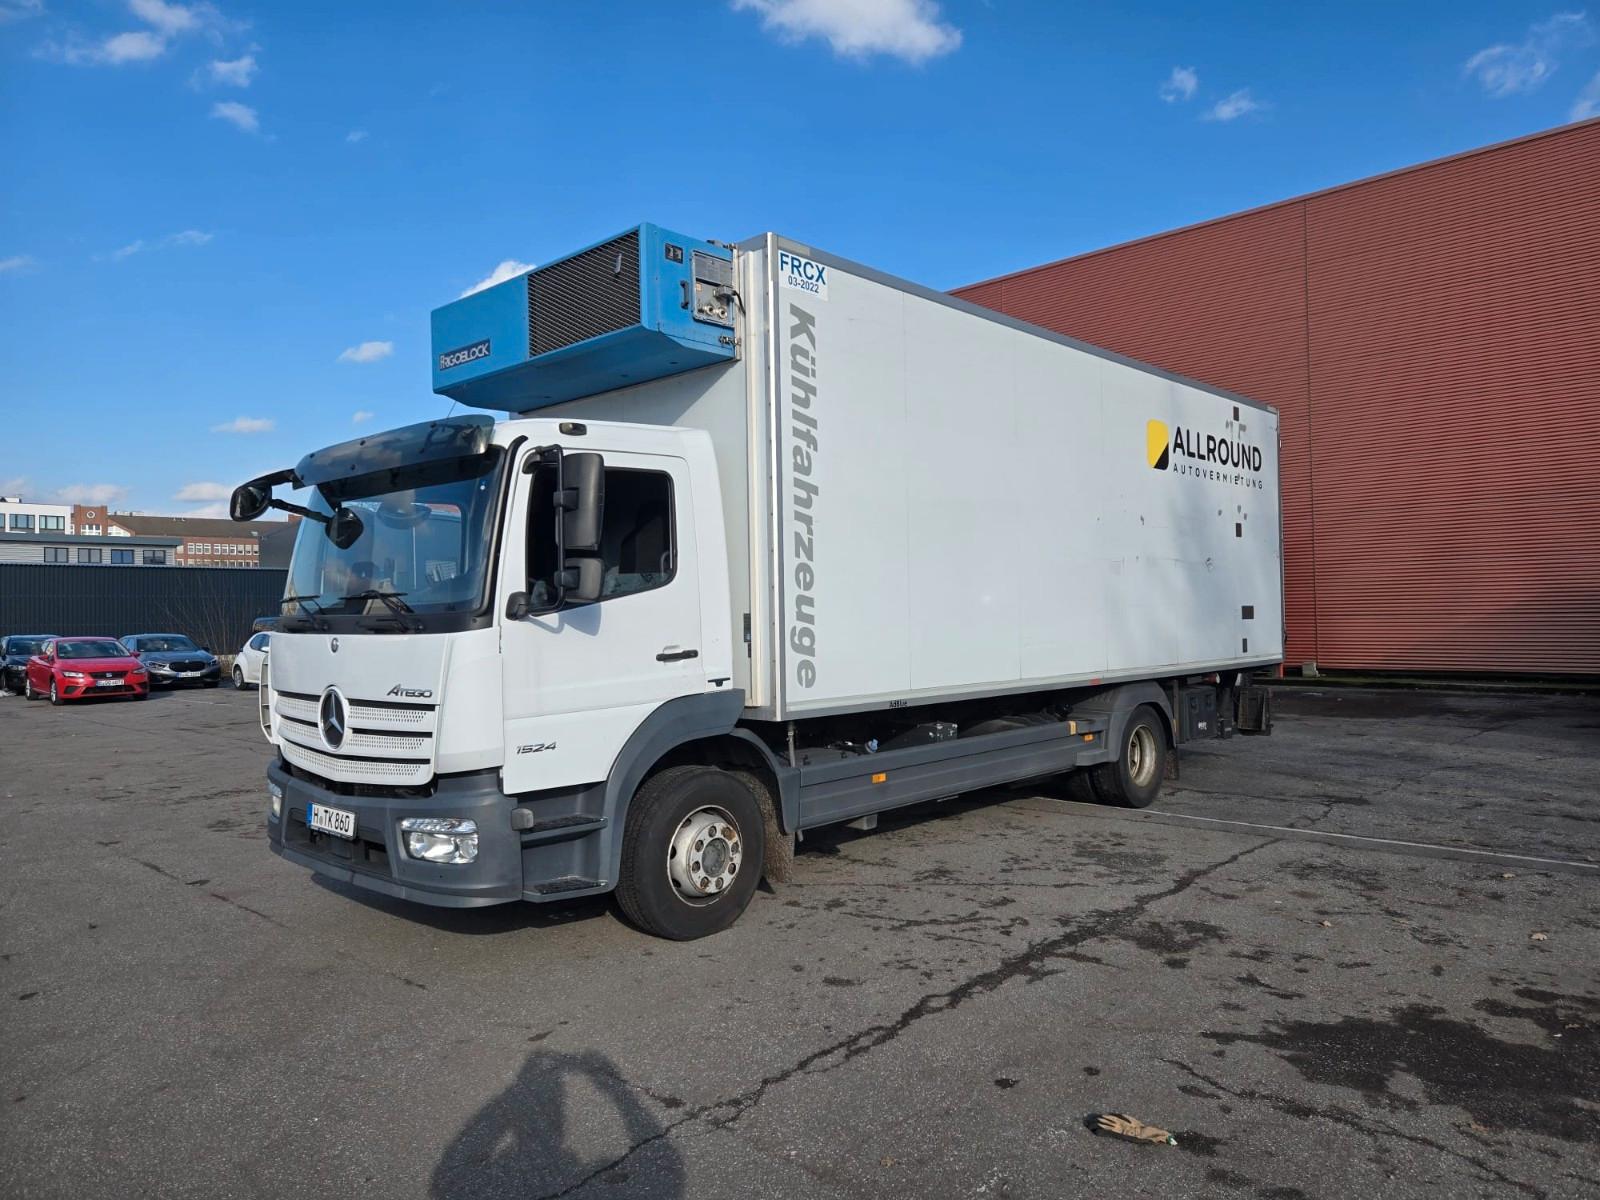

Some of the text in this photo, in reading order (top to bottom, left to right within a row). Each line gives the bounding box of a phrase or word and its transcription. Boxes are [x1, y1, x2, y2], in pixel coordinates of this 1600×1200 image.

[780, 252, 826, 285] FRCX
[788, 275, 819, 294] 03-2022
[1173, 426, 1262, 472] ALLROUND
[1173, 463, 1263, 489] AUTOVERMIETUNG
[789, 303, 819, 689] Kühlfahrzeuge
[516, 741, 557, 754] 1524
